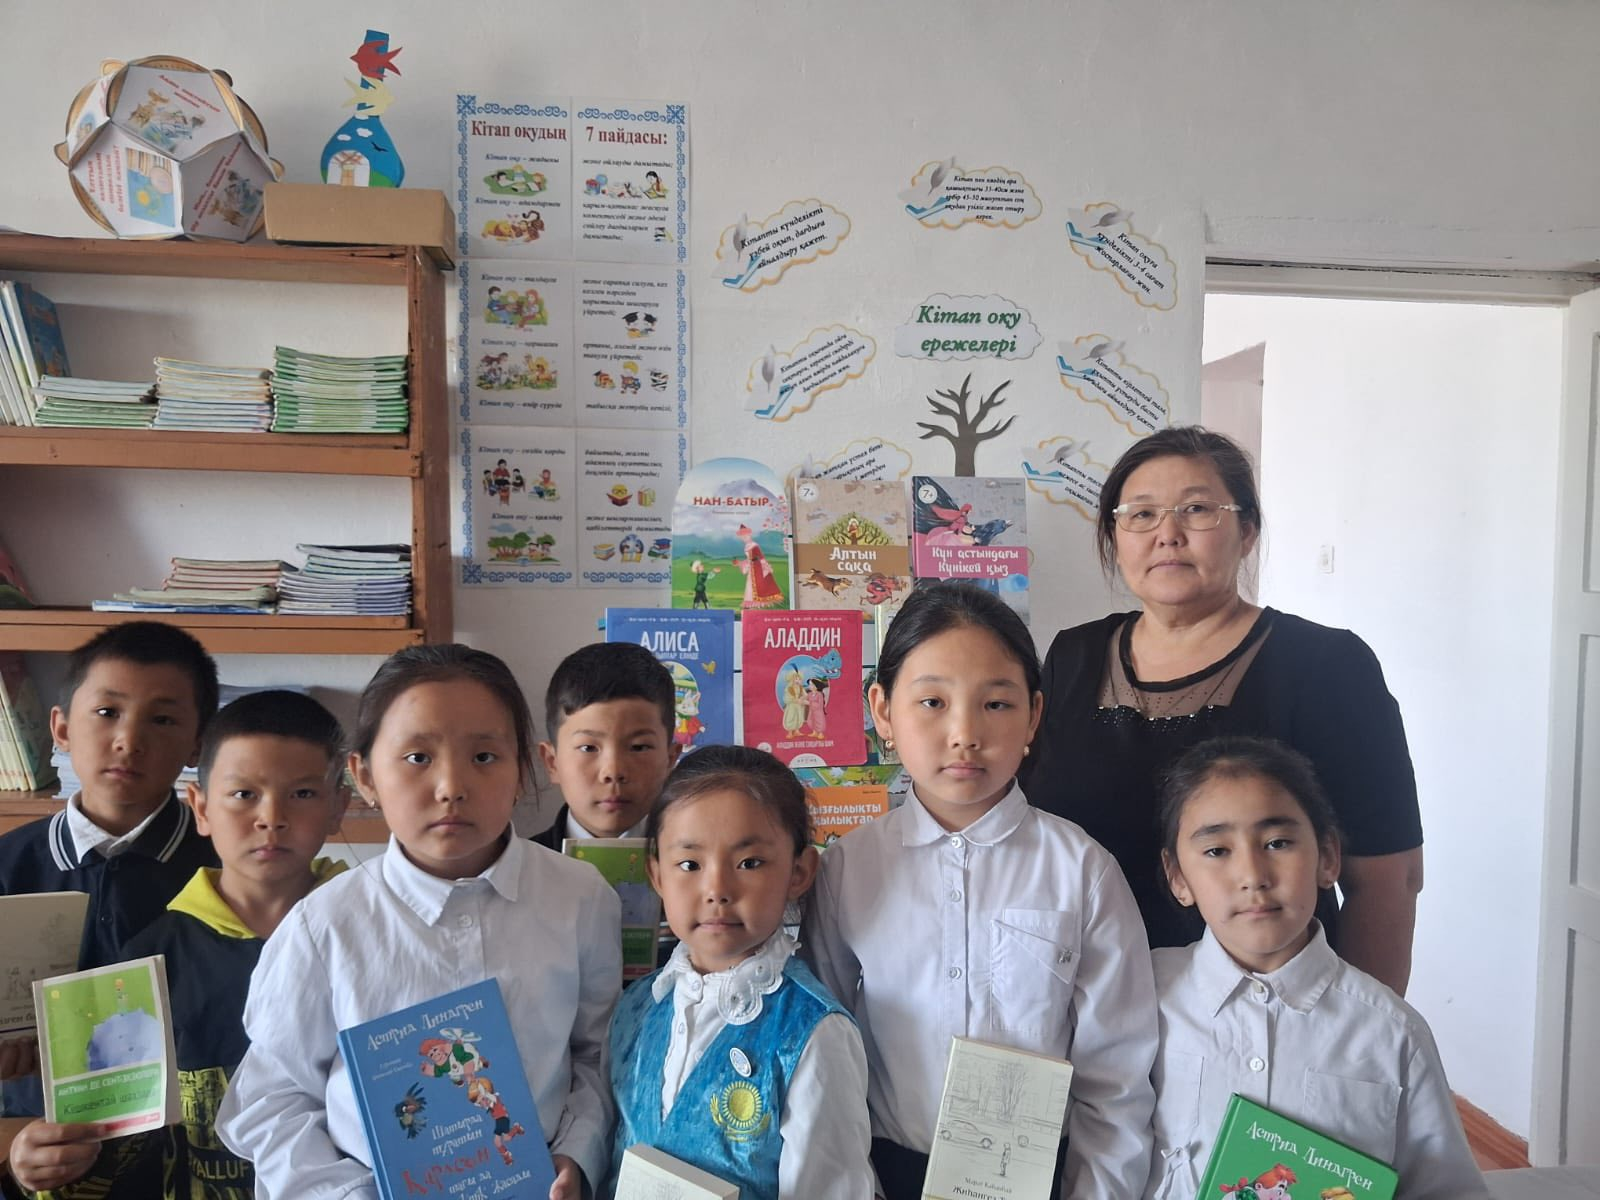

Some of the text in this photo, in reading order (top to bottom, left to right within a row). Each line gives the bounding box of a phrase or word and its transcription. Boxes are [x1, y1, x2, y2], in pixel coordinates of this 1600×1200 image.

[472, 120, 668, 145] Кітап оқудың 7 пайдасы:
[740, 207, 824, 249] Кітапты күнделікті
[796, 220, 826, 240] дағдыға
[757, 234, 828, 269] айналдыру қажет.
[1117, 232, 1140, 254] Кітап
[916, 305, 1021, 330] Кітап оқу
[921, 334, 1018, 357] ережелері
[693, 496, 769, 507] НАН-БАТЫР
[829, 546, 877, 562] Алтын
[931, 547, 1019, 564] Күн астындағы
[837, 560, 873, 574] сақа
[938, 560, 1009, 577] Күнікей қыз
[640, 630, 700, 652] АЛИСА
[764, 627, 842, 651] АЛАДДИН
[367, 999, 484, 1051] Астрид Линдгрен
[1245, 1120, 1374, 1191] Астрид Линдгрен
